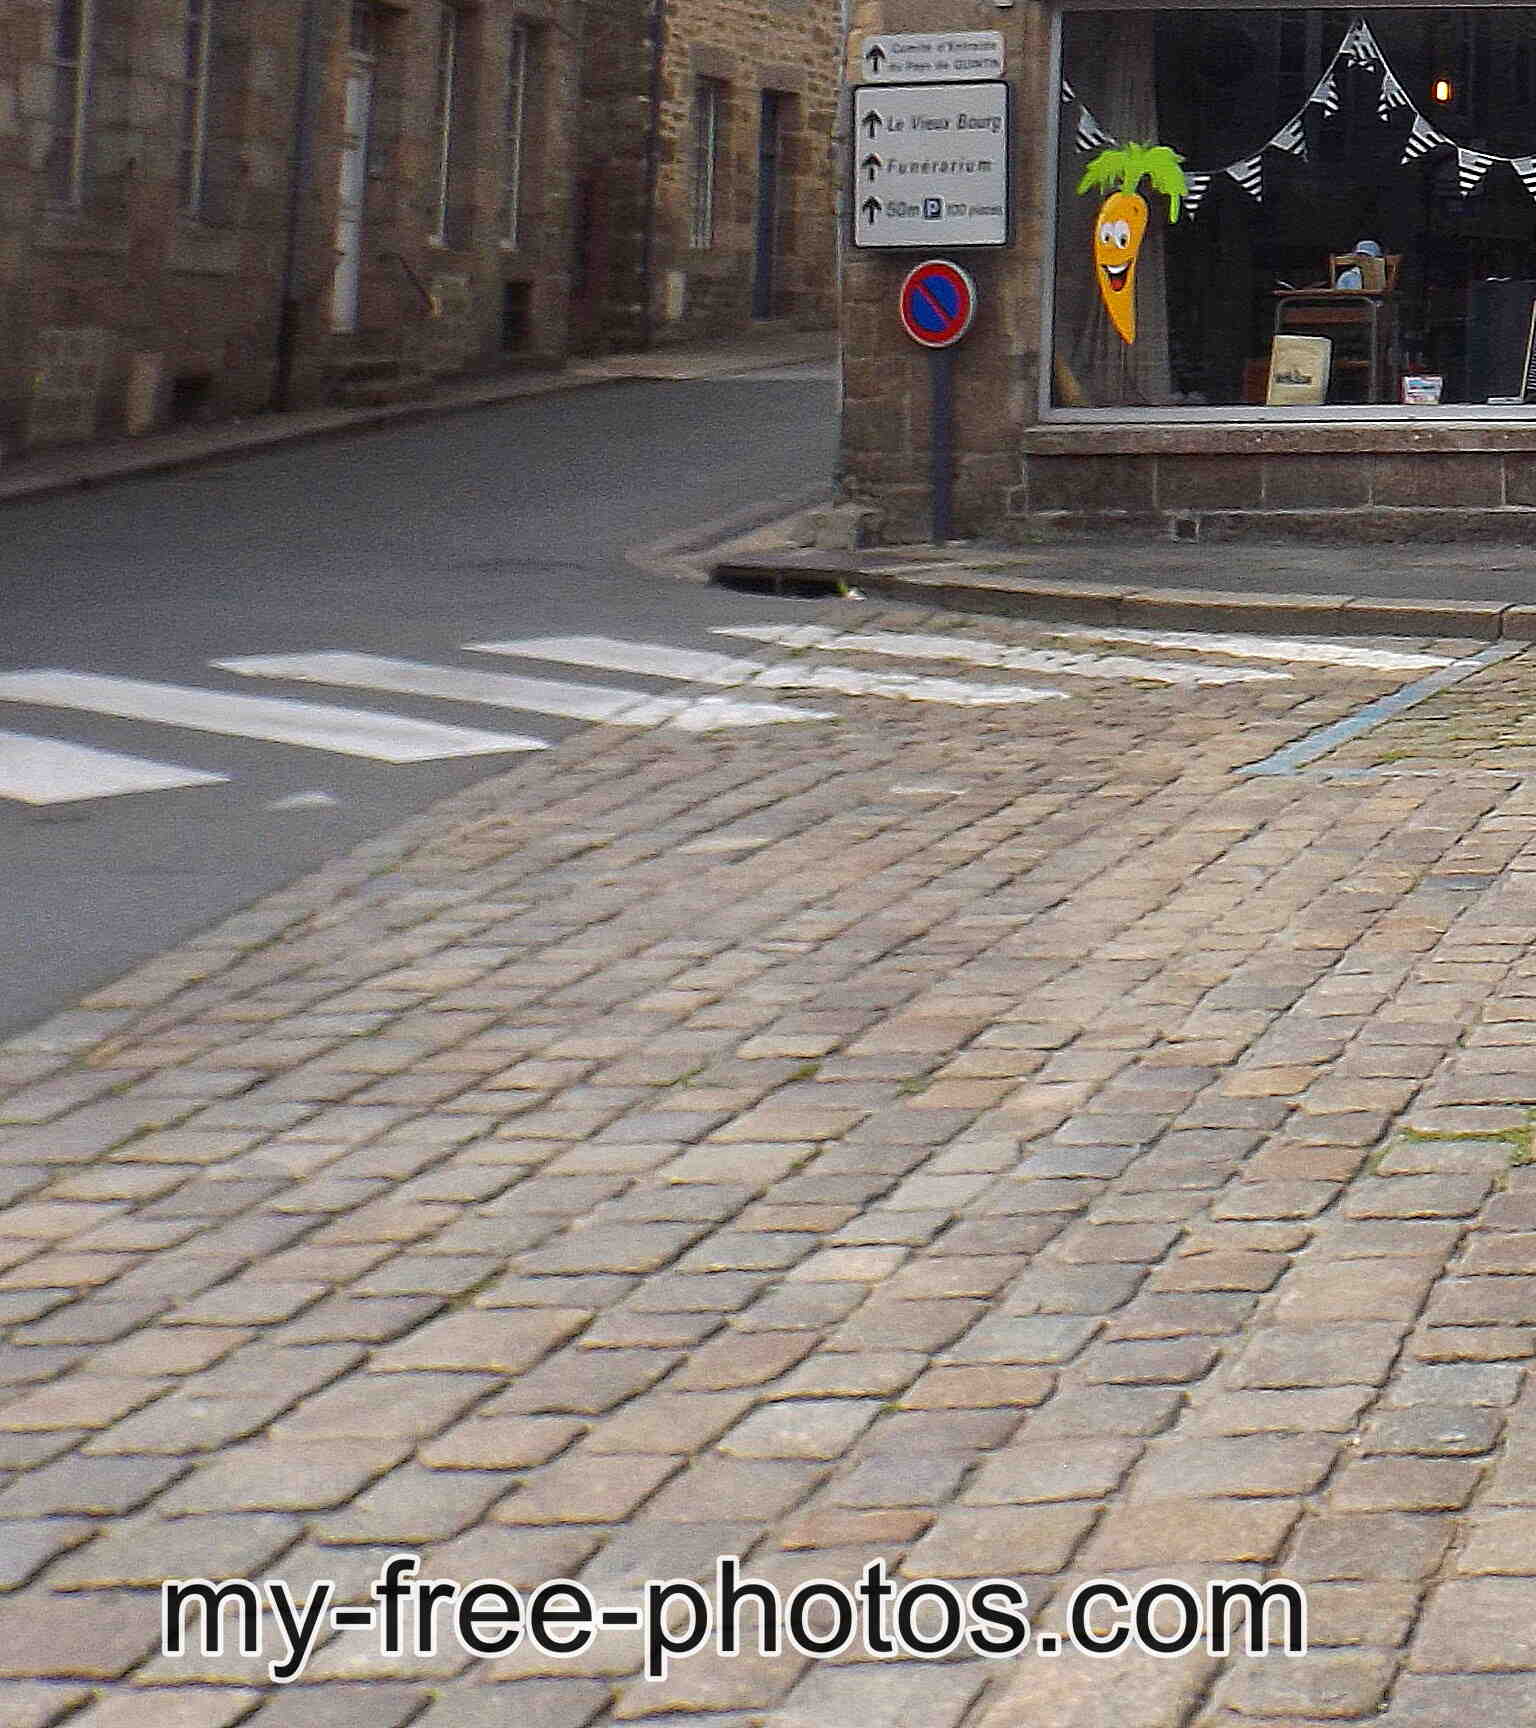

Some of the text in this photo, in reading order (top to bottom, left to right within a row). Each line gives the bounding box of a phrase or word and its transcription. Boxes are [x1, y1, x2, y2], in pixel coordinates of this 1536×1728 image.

[887, 113, 1002, 134] Le Vieux Bourg
[887, 158, 993, 174] Funérarium
